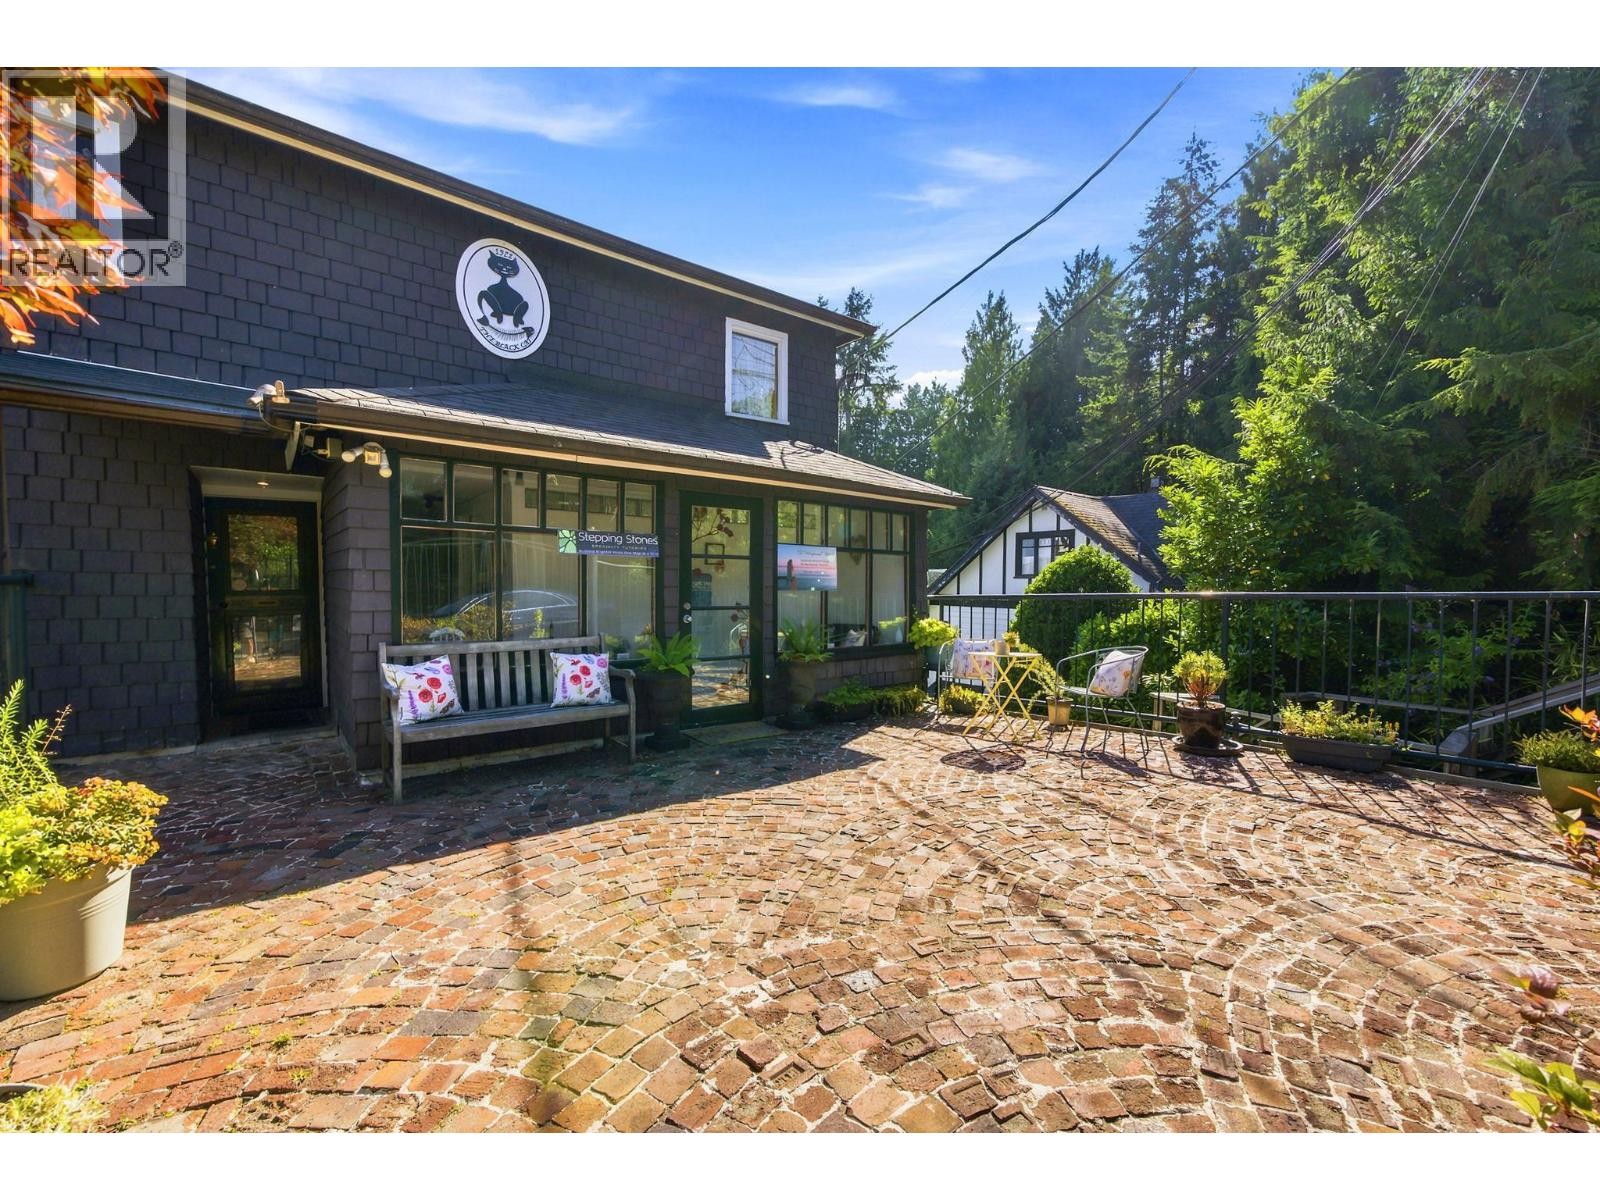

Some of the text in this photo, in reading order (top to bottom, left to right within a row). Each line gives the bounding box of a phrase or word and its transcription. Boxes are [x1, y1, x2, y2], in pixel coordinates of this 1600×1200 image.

[495, 341, 520, 351] BLACK
[578, 531, 659, 545] Stepping Stones
